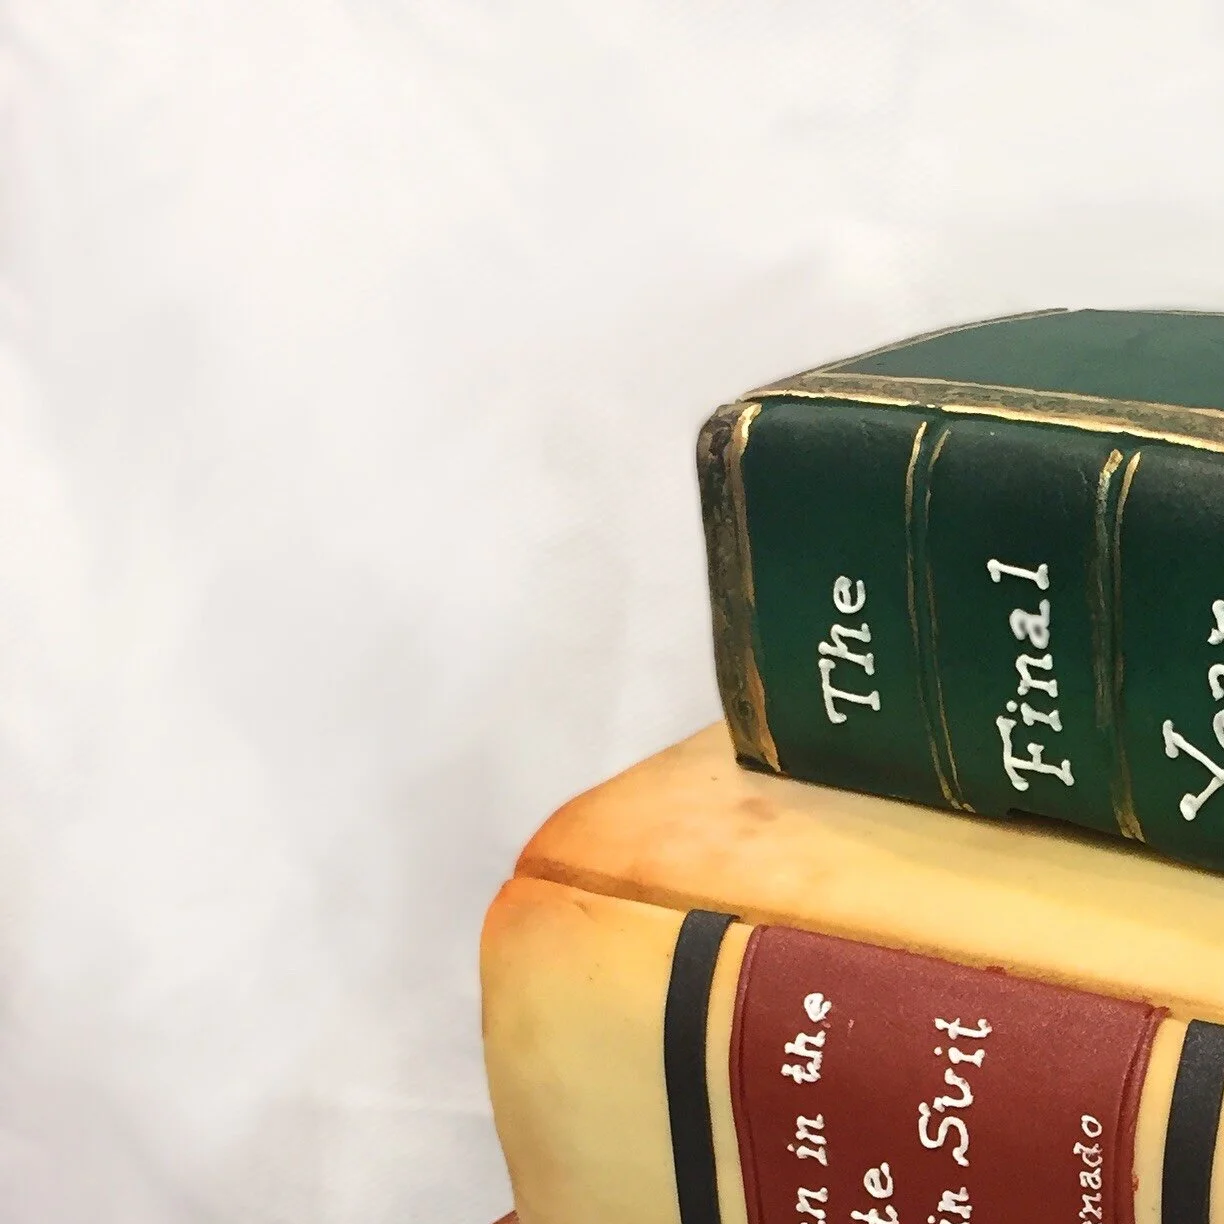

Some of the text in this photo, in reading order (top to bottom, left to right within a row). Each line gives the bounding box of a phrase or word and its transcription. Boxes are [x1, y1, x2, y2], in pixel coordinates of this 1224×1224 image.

[818, 575, 881, 724] The
[986, 558, 1075, 792] Final
[780, 992, 833, 1084] the
[918, 1017, 993, 1167] Suit
[786, 1113, 828, 1166] in
